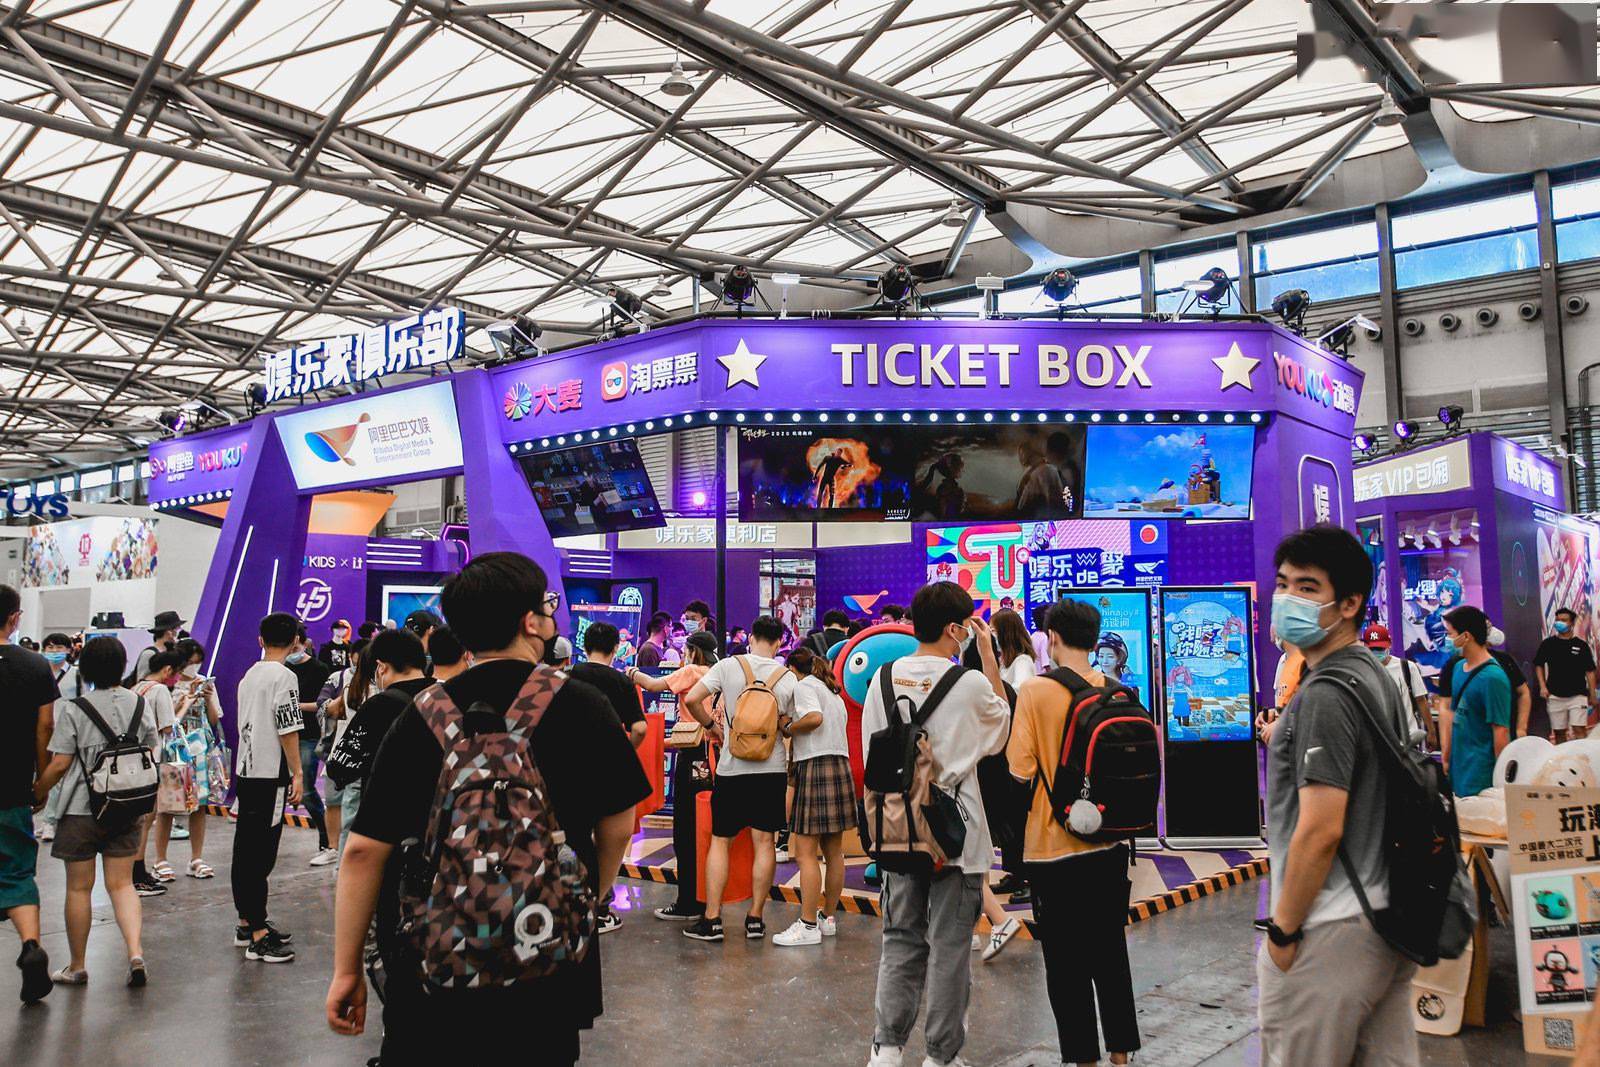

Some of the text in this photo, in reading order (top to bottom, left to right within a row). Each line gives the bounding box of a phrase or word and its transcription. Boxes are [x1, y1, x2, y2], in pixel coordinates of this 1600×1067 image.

[265, 306, 462, 404] 娱乐家俱乐部
[831, 343, 1153, 388] TICKET BOX
[630, 352, 698, 394] 淘票票
[534, 379, 584, 416] 大麦
[368, 416, 431, 443] 阿里巴巴文娱
[167, 451, 195, 475] 阿里鱼
[198, 446, 242, 473] YOUKU
[308, 555, 336, 569] KIDS
[1029, 553, 1073, 578] 娱乐
[1076, 569, 1099, 585] de
[1519, 836, 1583, 852] 中国最大二次元
[1530, 848, 1584, 862] 商品交易社区
